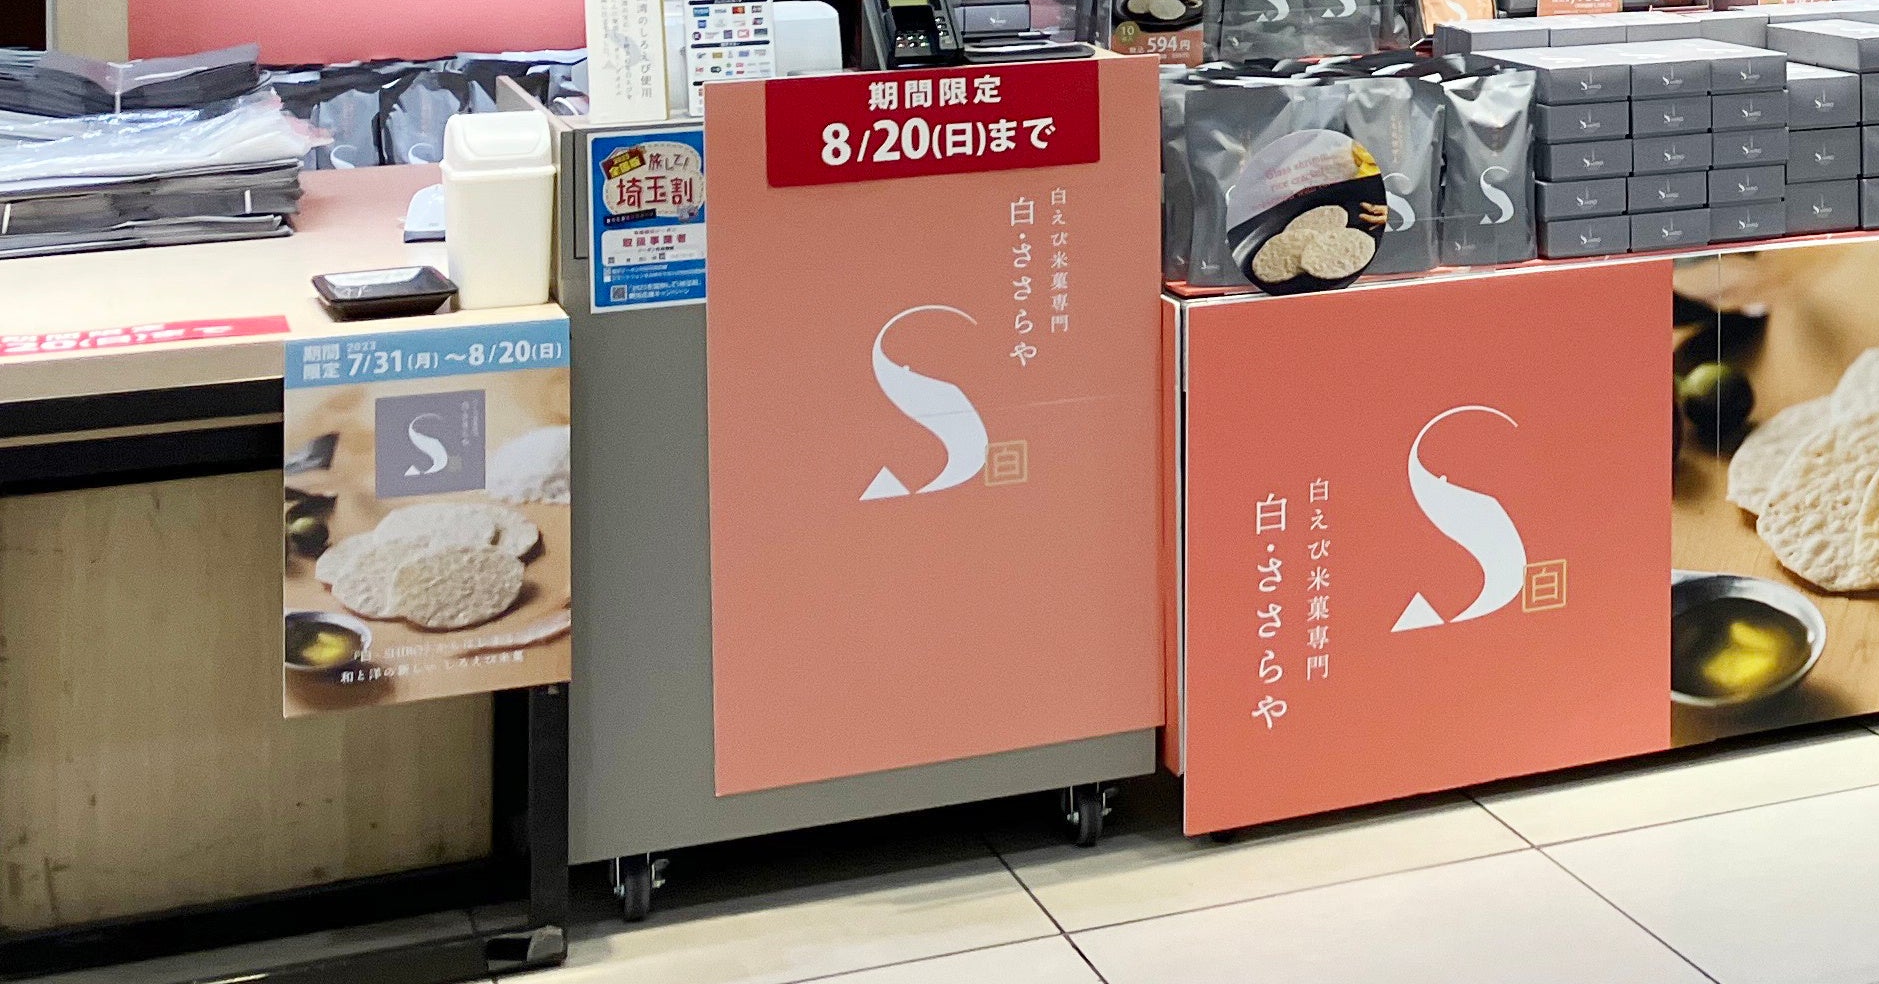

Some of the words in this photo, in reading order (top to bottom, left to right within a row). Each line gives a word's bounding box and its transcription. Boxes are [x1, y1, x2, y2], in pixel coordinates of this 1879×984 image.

[867, 74, 1002, 111] 期間限定
[820, 115, 1057, 166] 8/20(日)まで
[615, 175, 695, 210] 埼玉割
[1049, 186, 1070, 334] 白えび米菓専門
[1306, 476, 1331, 682] 白えび米菓専門
